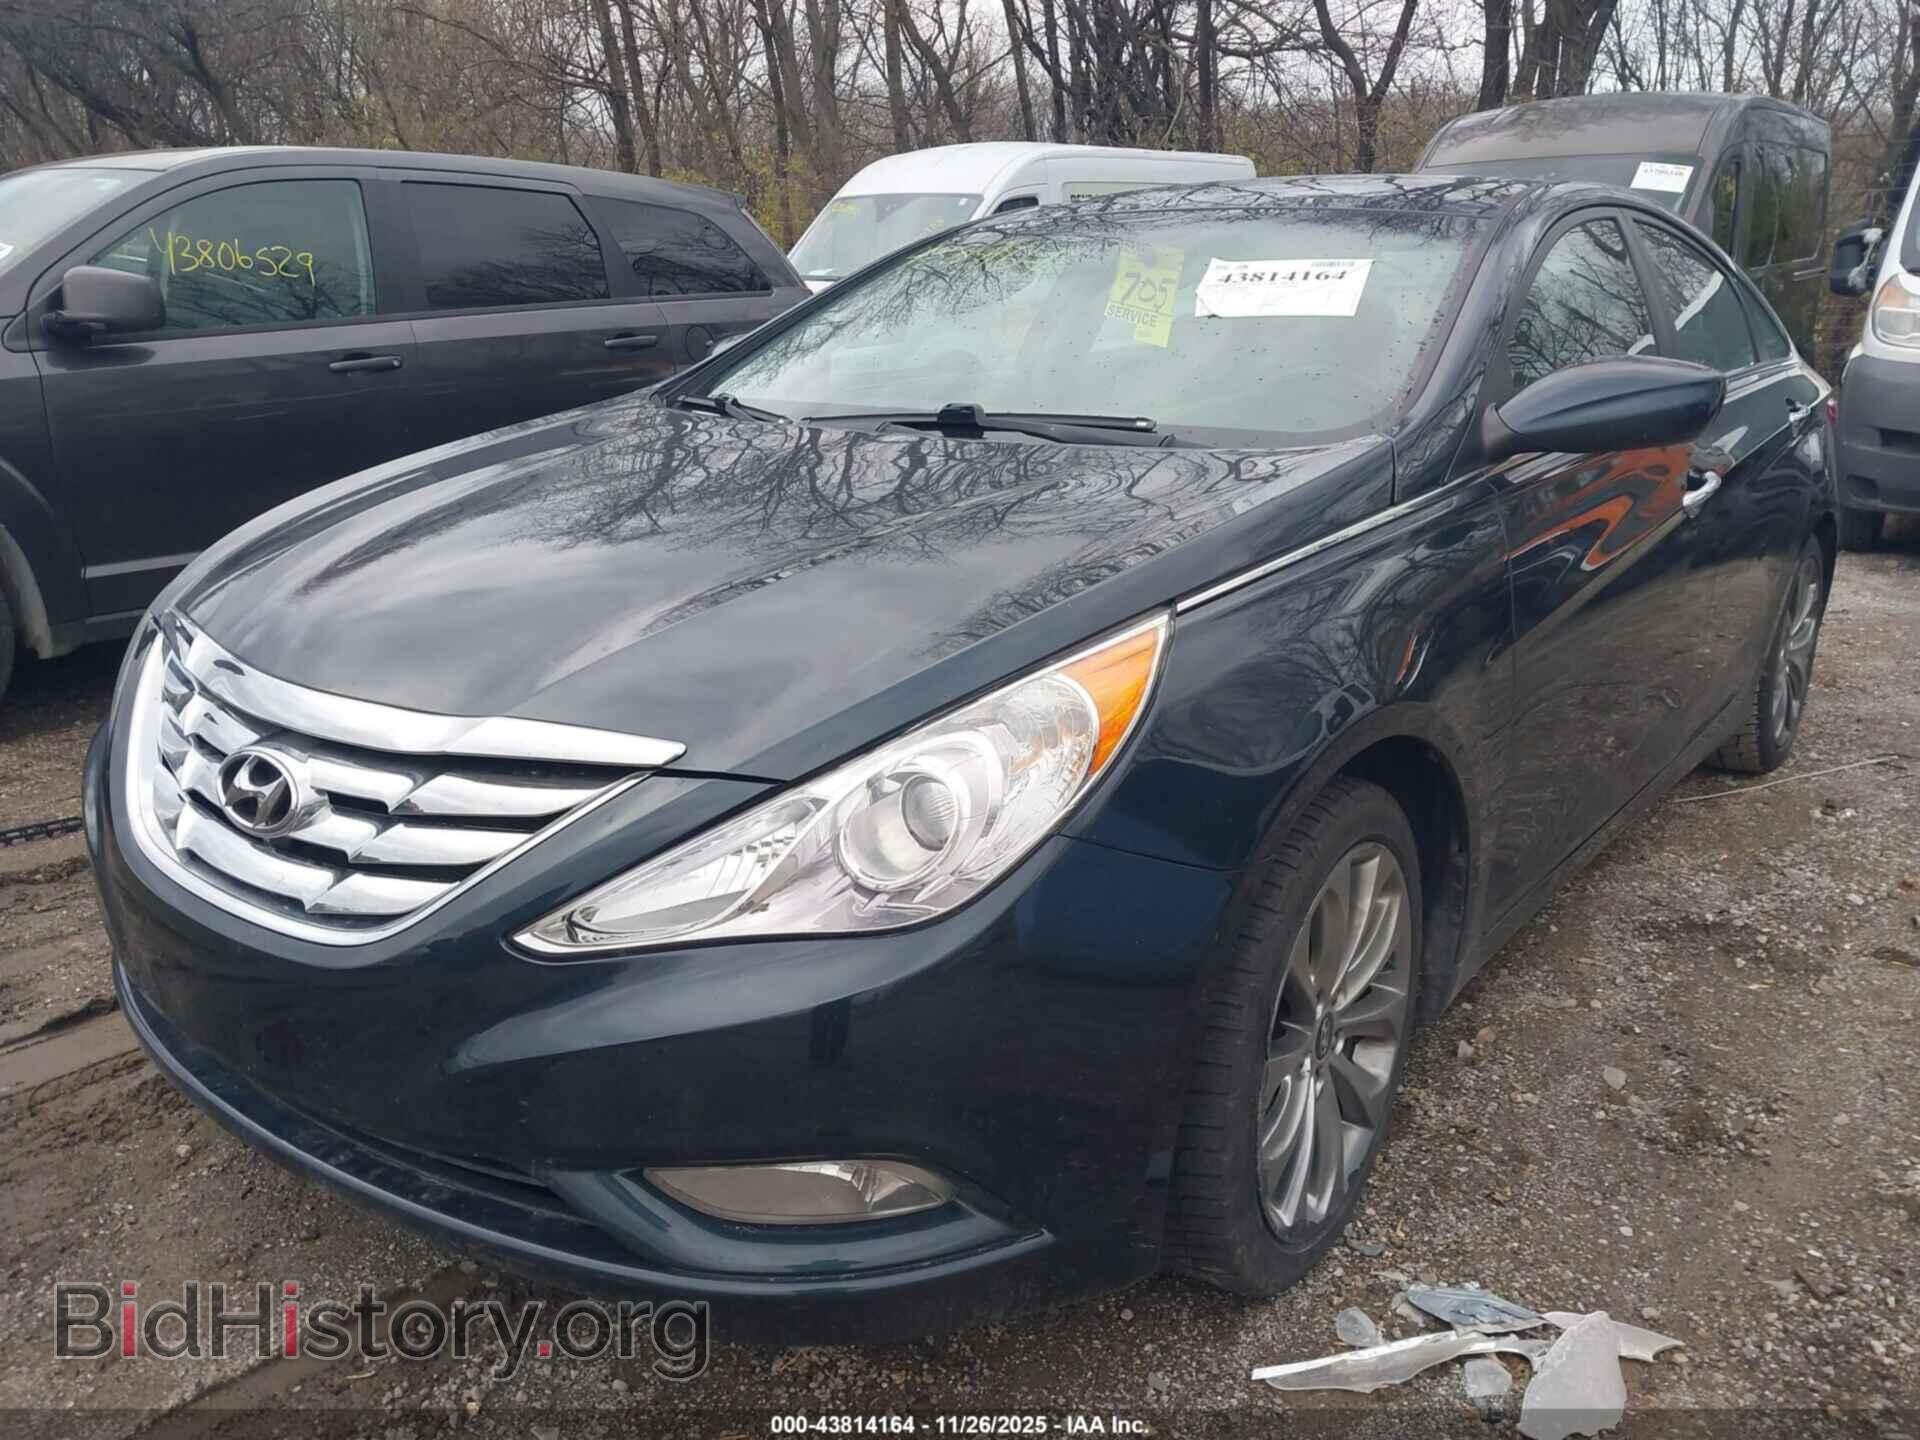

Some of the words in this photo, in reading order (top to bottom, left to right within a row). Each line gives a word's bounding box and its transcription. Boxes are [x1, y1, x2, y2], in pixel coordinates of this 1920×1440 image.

[149, 227, 315, 287] 43806529
[1119, 272, 1176, 313] 705
[1216, 270, 1347, 283] 43814164
[1106, 303, 1159, 328] SERVICE
